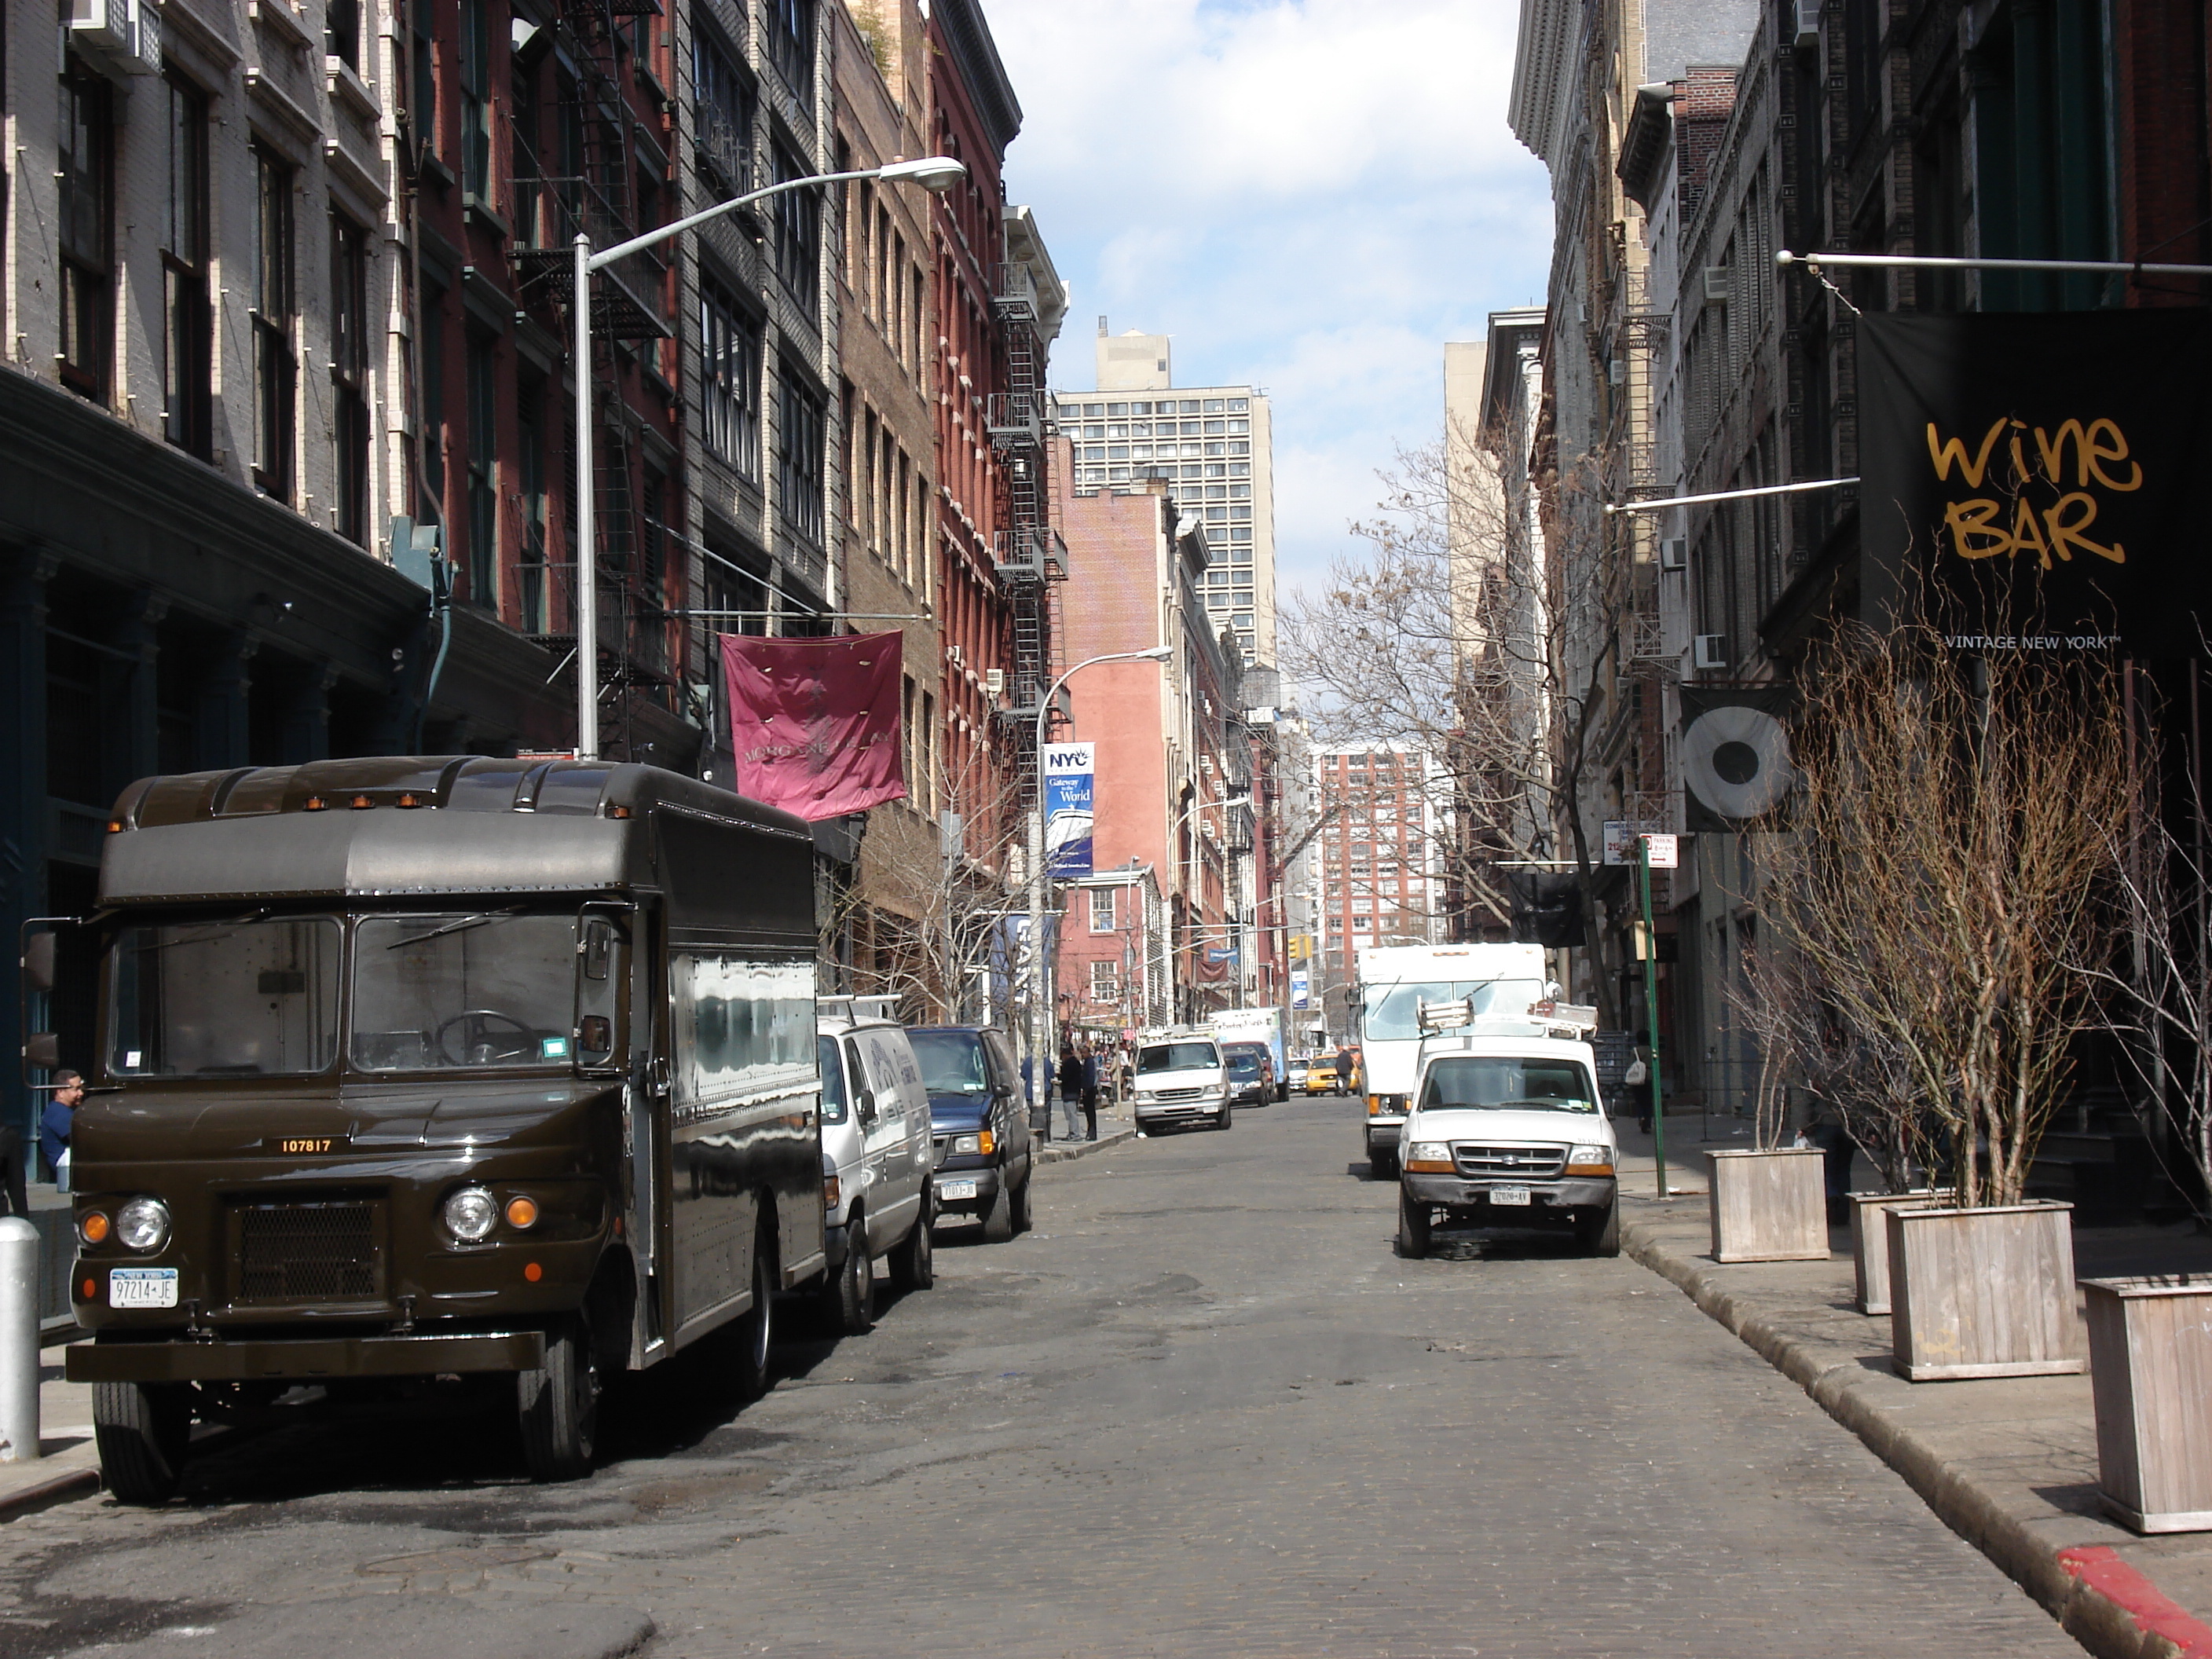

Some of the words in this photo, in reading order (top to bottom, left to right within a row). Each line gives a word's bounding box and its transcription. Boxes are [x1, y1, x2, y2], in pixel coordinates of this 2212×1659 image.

[1944, 492, 2126, 570] BAR
[1945, 635, 2016, 649] VINTAGE
[2023, 636, 2060, 650] NEW
[1049, 752, 1088, 767] NYC
[1049, 778, 1079, 788] Gateway
[1060, 789, 1090, 802] World
[283, 1140, 331, 1152] 107817
